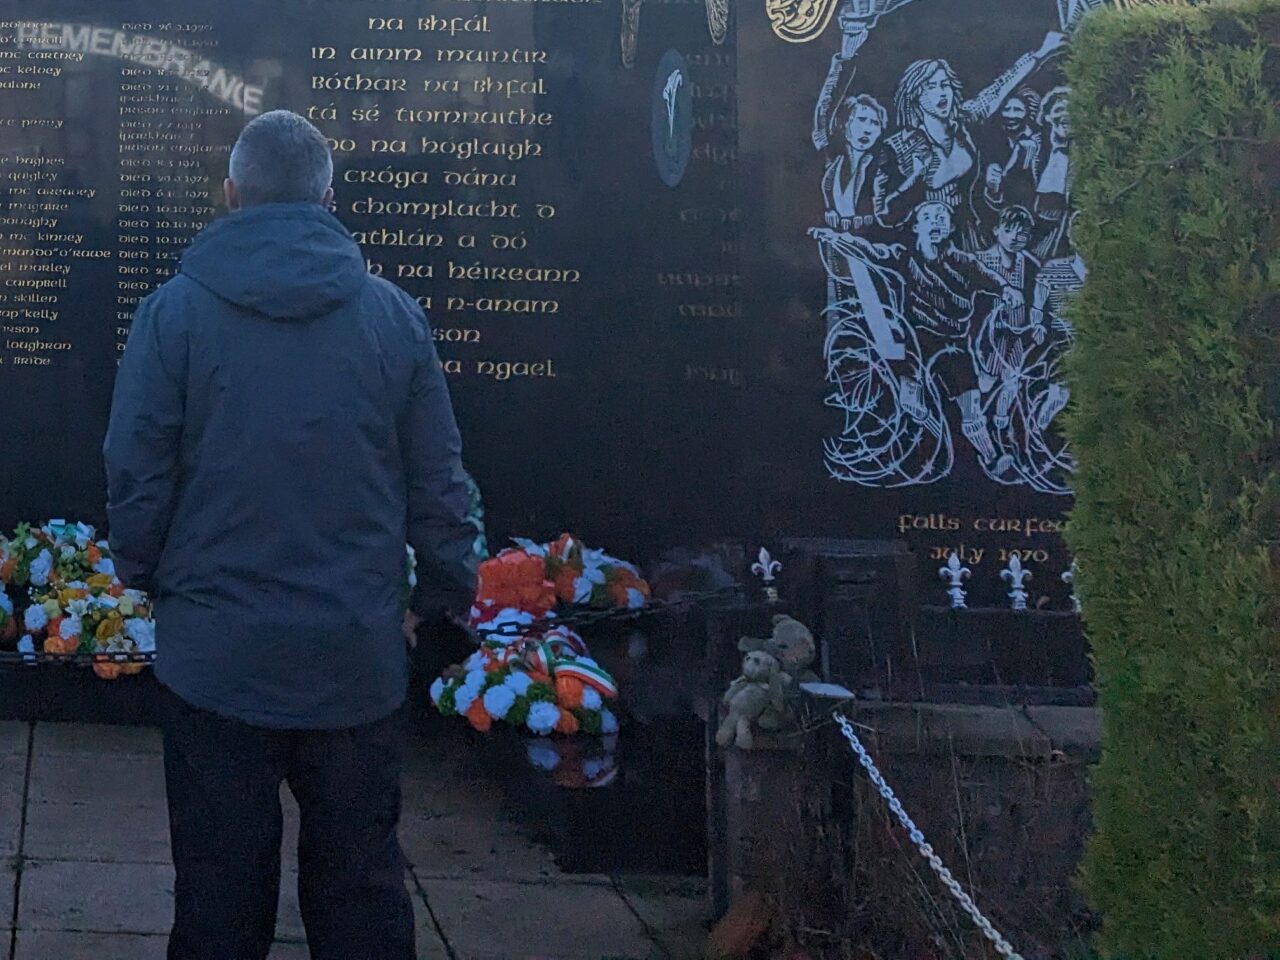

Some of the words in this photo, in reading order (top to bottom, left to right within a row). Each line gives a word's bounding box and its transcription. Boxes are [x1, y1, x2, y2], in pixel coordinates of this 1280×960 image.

[369, 16, 403, 31] na
[418, 15, 490, 36] bhfál
[311, 46, 336, 59] in
[351, 48, 421, 61] ainm
[437, 49, 549, 64] muintir
[312, 72, 406, 91] bóthar
[424, 79, 458, 92] na
[307, 105, 336, 120] tá
[352, 105, 379, 121] sé
[396, 108, 552, 126] tiomnaithe
[371, 139, 406, 152] na
[421, 136, 542, 160] hóglaigh
[344, 166, 428, 189] cróga
[352, 198, 519, 219] chomplacht
[352, 229, 443, 247] athlán
[458, 236, 474, 248] a
[492, 231, 526, 249] dó
[399, 264, 432, 278] na
[449, 261, 579, 281] héireann
[5, 277, 67, 289] campbell
[448, 298, 559, 314] n-anam
[432, 326, 480, 342] son
[477, 359, 555, 380] ngael
[898, 514, 960, 533] falls
[1000, 547, 1048, 562] 1970
